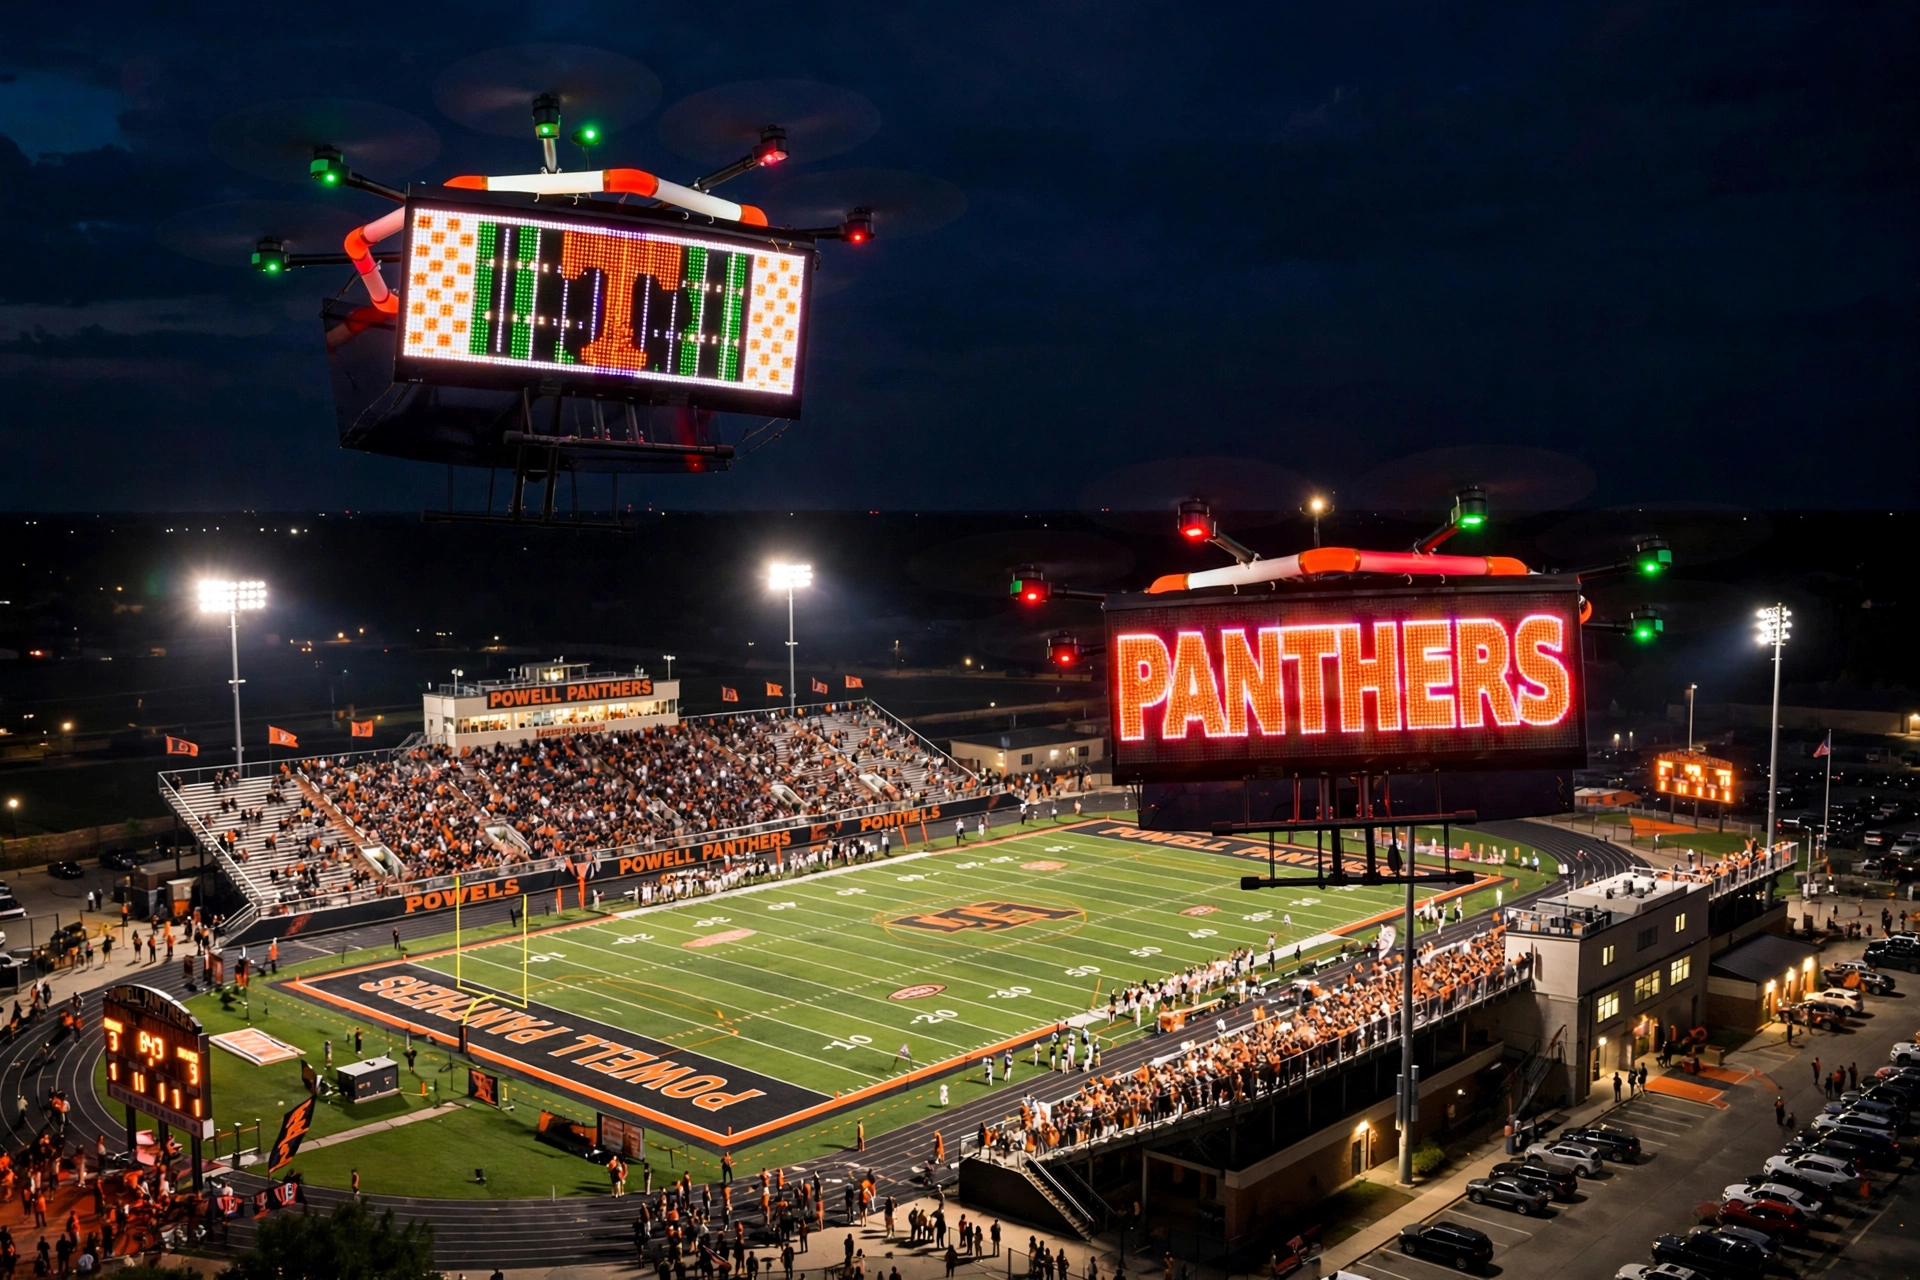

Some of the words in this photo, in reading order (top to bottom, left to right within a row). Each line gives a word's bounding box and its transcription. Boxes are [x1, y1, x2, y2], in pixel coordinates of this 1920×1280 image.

[561, 230, 682, 371] T
[490, 689, 562, 708] POWELL
[567, 680, 652, 701] PANTHERS
[1116, 614, 1571, 741] PANTHERS
[619, 849, 696, 875] POWELL
[702, 831, 791, 860] PANTHERS
[404, 878, 520, 914] POWELS
[1064, 965, 1101, 977] 50
[915, 1009, 959, 1024] 20
[359, 975, 574, 1044] PANTHERS
[547, 1034, 767, 1112] POWELL
[831, 1035, 873, 1051] 10
